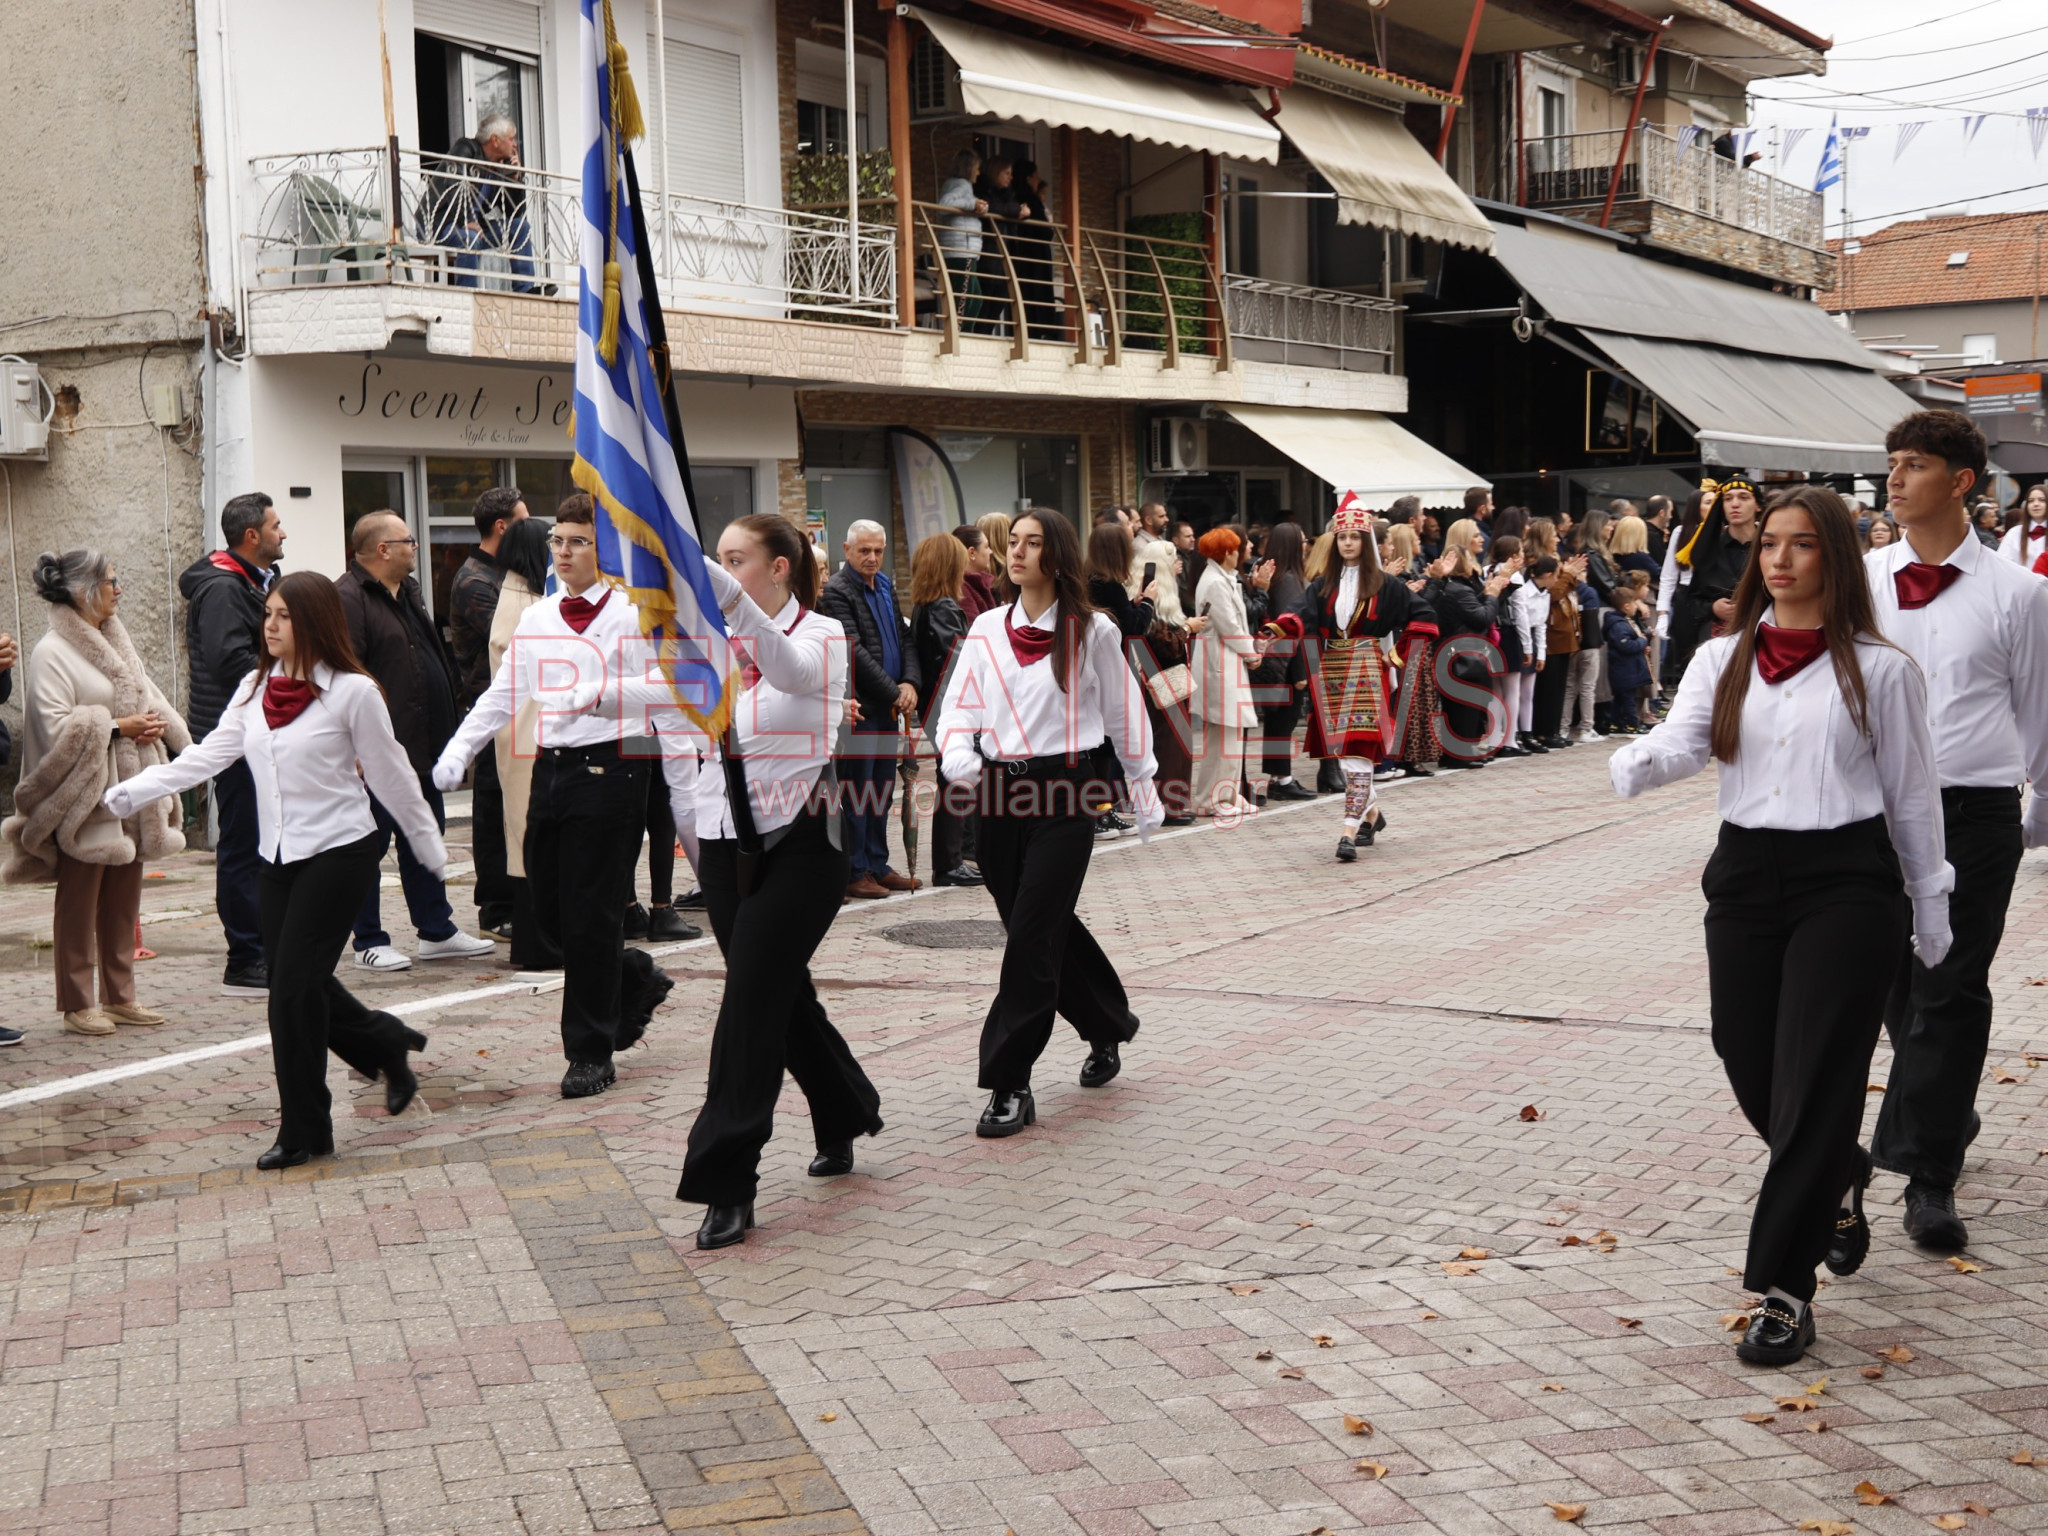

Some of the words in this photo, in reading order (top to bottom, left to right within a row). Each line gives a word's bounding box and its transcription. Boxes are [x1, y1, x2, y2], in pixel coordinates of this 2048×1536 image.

[339, 362, 490, 421] Scent
[515, 375, 574, 426] Se
[460, 424, 488, 447] Style
[490, 429, 501, 443] &
[502, 427, 531, 445] Scent
